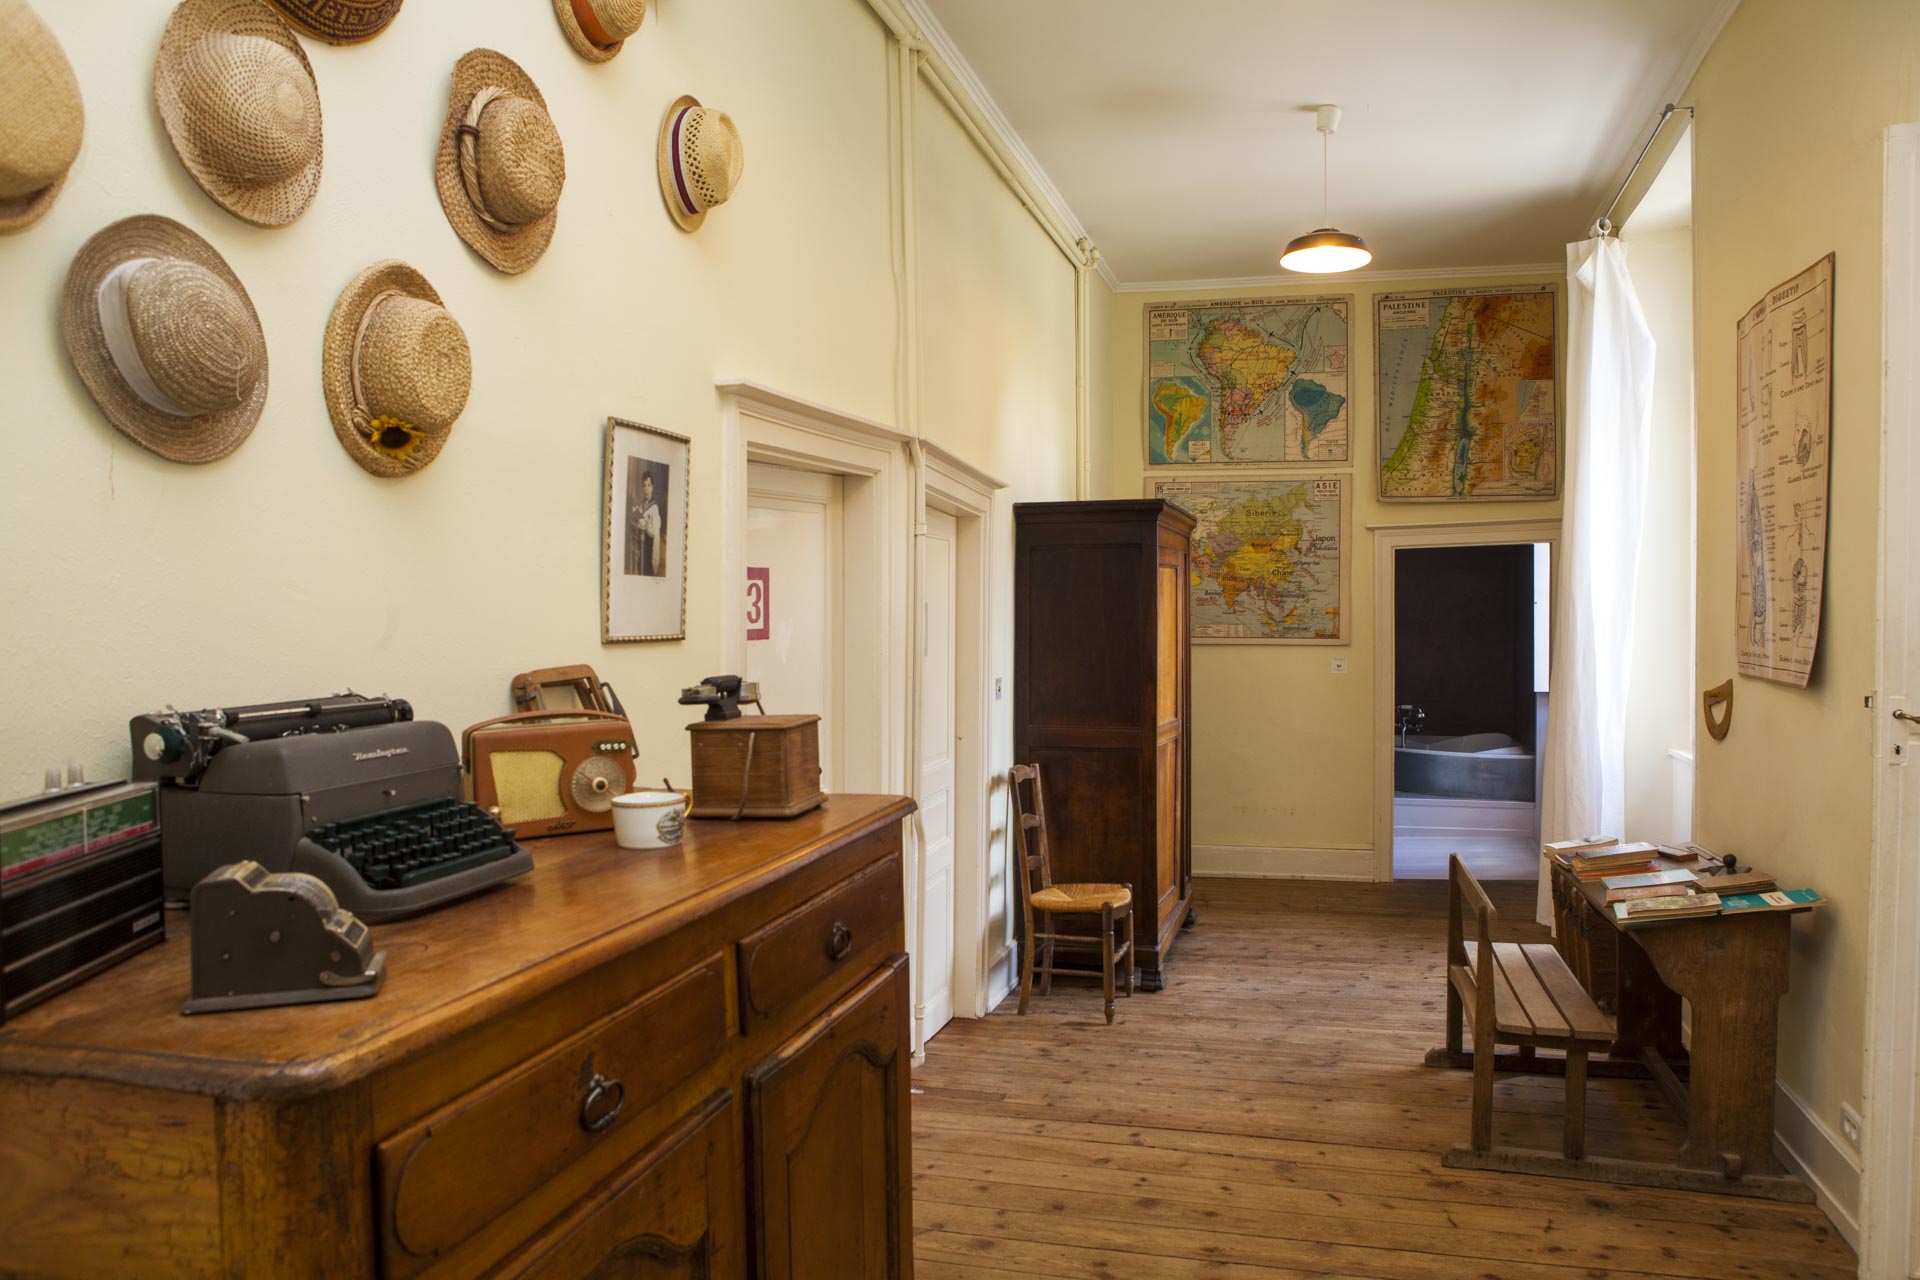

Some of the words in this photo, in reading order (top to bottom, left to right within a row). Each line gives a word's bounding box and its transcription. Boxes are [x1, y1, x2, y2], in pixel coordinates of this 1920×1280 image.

[1772, 283, 1799, 305] DIGESTIF
[1383, 302, 1427, 310] PALESTINE
[1152, 311, 1187, 319] AMÉRIQUE
[1156, 485, 1164, 493] 15
[1315, 534, 1336, 544] Japon
[1271, 568, 1294, 577] Chine
[746, 582, 761, 624] 3
